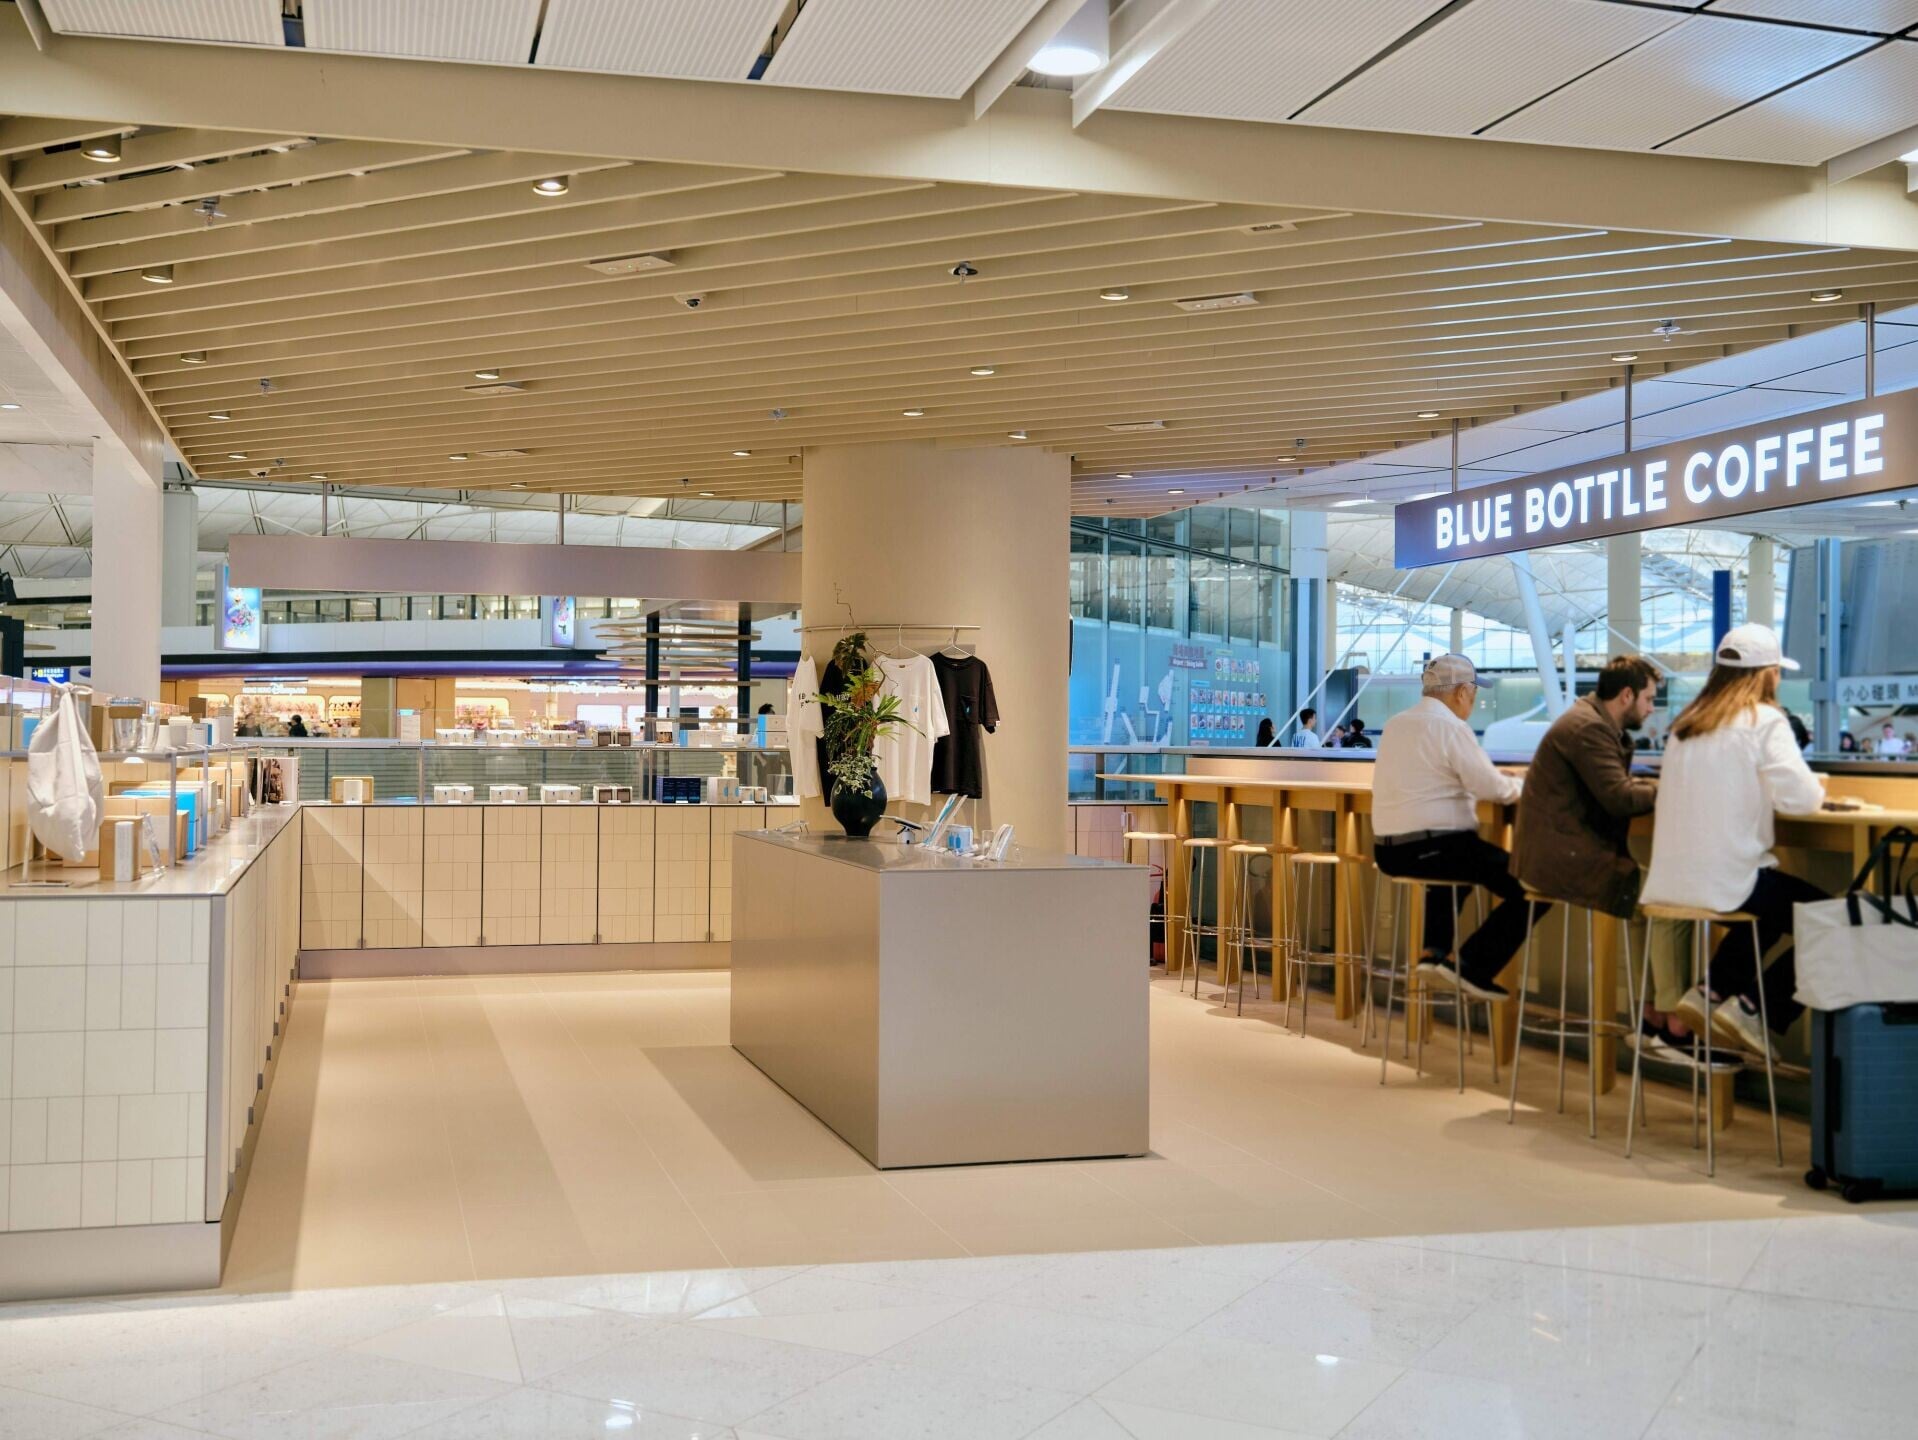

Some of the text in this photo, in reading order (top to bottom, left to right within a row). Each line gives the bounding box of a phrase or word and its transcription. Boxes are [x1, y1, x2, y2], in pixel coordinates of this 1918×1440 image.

[1436, 414, 1884, 549] BLUE BOTTLE COFFEE
